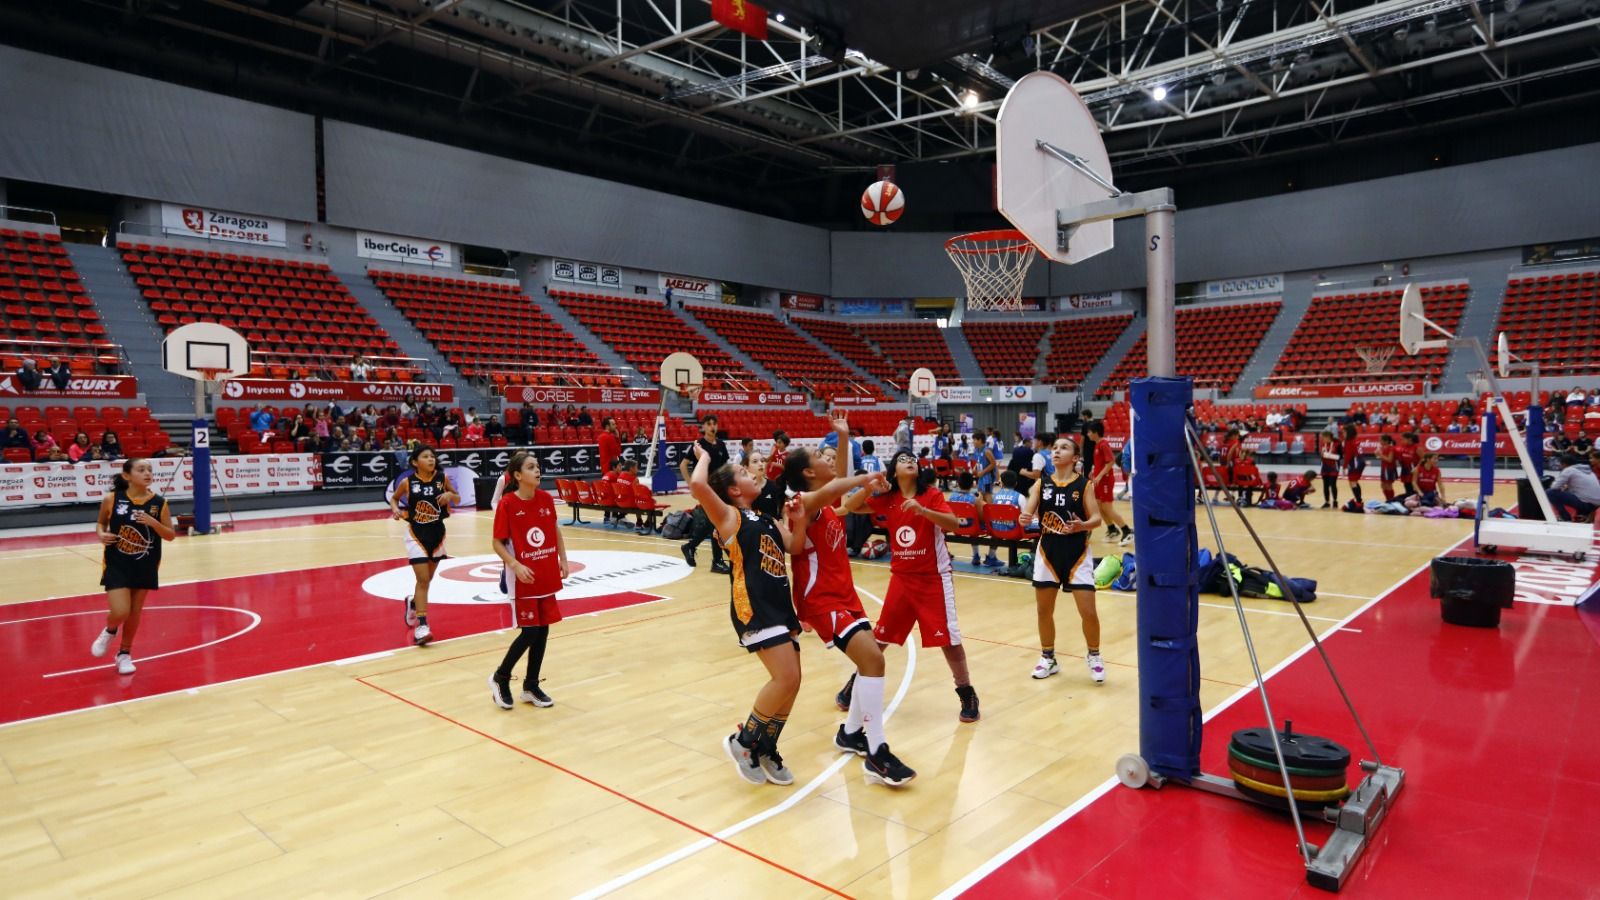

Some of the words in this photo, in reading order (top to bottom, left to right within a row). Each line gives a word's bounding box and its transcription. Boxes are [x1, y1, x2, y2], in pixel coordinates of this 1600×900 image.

[209, 211, 269, 236] Zaragoza
[364, 238, 418, 257] iberCaja
[1149, 234, 1161, 251] S
[246, 386, 285, 395] Inycom
[308, 387, 344, 395] Inycom
[383, 386, 441, 396] ANAGAN
[1343, 384, 1414, 394] ALEJANDRO
[535, 390, 576, 402] ORBE
[197, 431, 208, 444] 2
[423, 487, 434, 495] 22
[1054, 493, 1066, 506] 15
